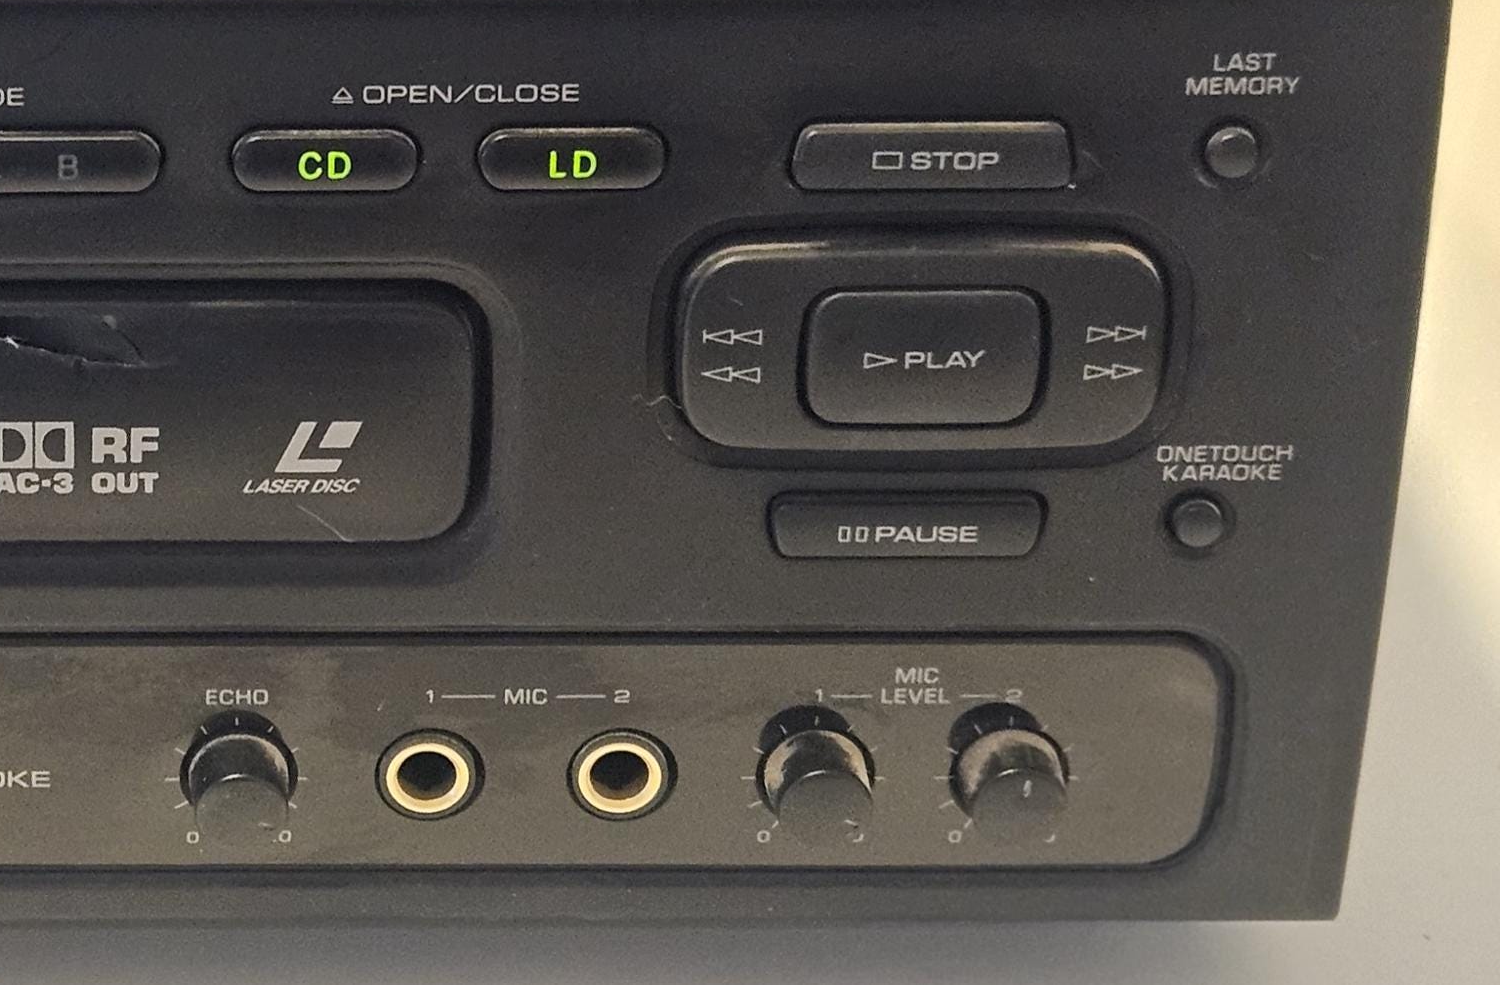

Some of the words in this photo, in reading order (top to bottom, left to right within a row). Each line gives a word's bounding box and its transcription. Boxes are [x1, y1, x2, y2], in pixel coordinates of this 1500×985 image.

[1212, 54, 1277, 72] LAST
[362, 84, 580, 105] OPEN/CLOSE
[1185, 77, 1299, 96] MEMORY
[57, 155, 79, 182] B
[297, 153, 352, 181] CD
[547, 152, 597, 179] LD
[910, 151, 999, 171] STOP
[904, 350, 986, 370] PLAY
[92, 427, 160, 464] RF
[1156, 445, 1294, 462] ONETOUCH
[1162, 464, 1283, 482] KARAOKE
[92, 471, 159, 495] OUT
[242, 478, 309, 495] LASER
[310, 477, 362, 494] DISC
[874, 525, 978, 544] PAUSE
[895, 667, 940, 685] MIC
[205, 688, 269, 706] ECHO
[426, 689, 434, 703] 1
[503, 689, 548, 705] MIC
[614, 689, 630, 704] 2
[815, 689, 823, 703] 1
[880, 688, 951, 705] LEVEL
[1006, 688, 1023, 703] 2
[186, 830, 200, 844] 0
[757, 830, 770, 843] 0
[948, 830, 961, 843] 0
